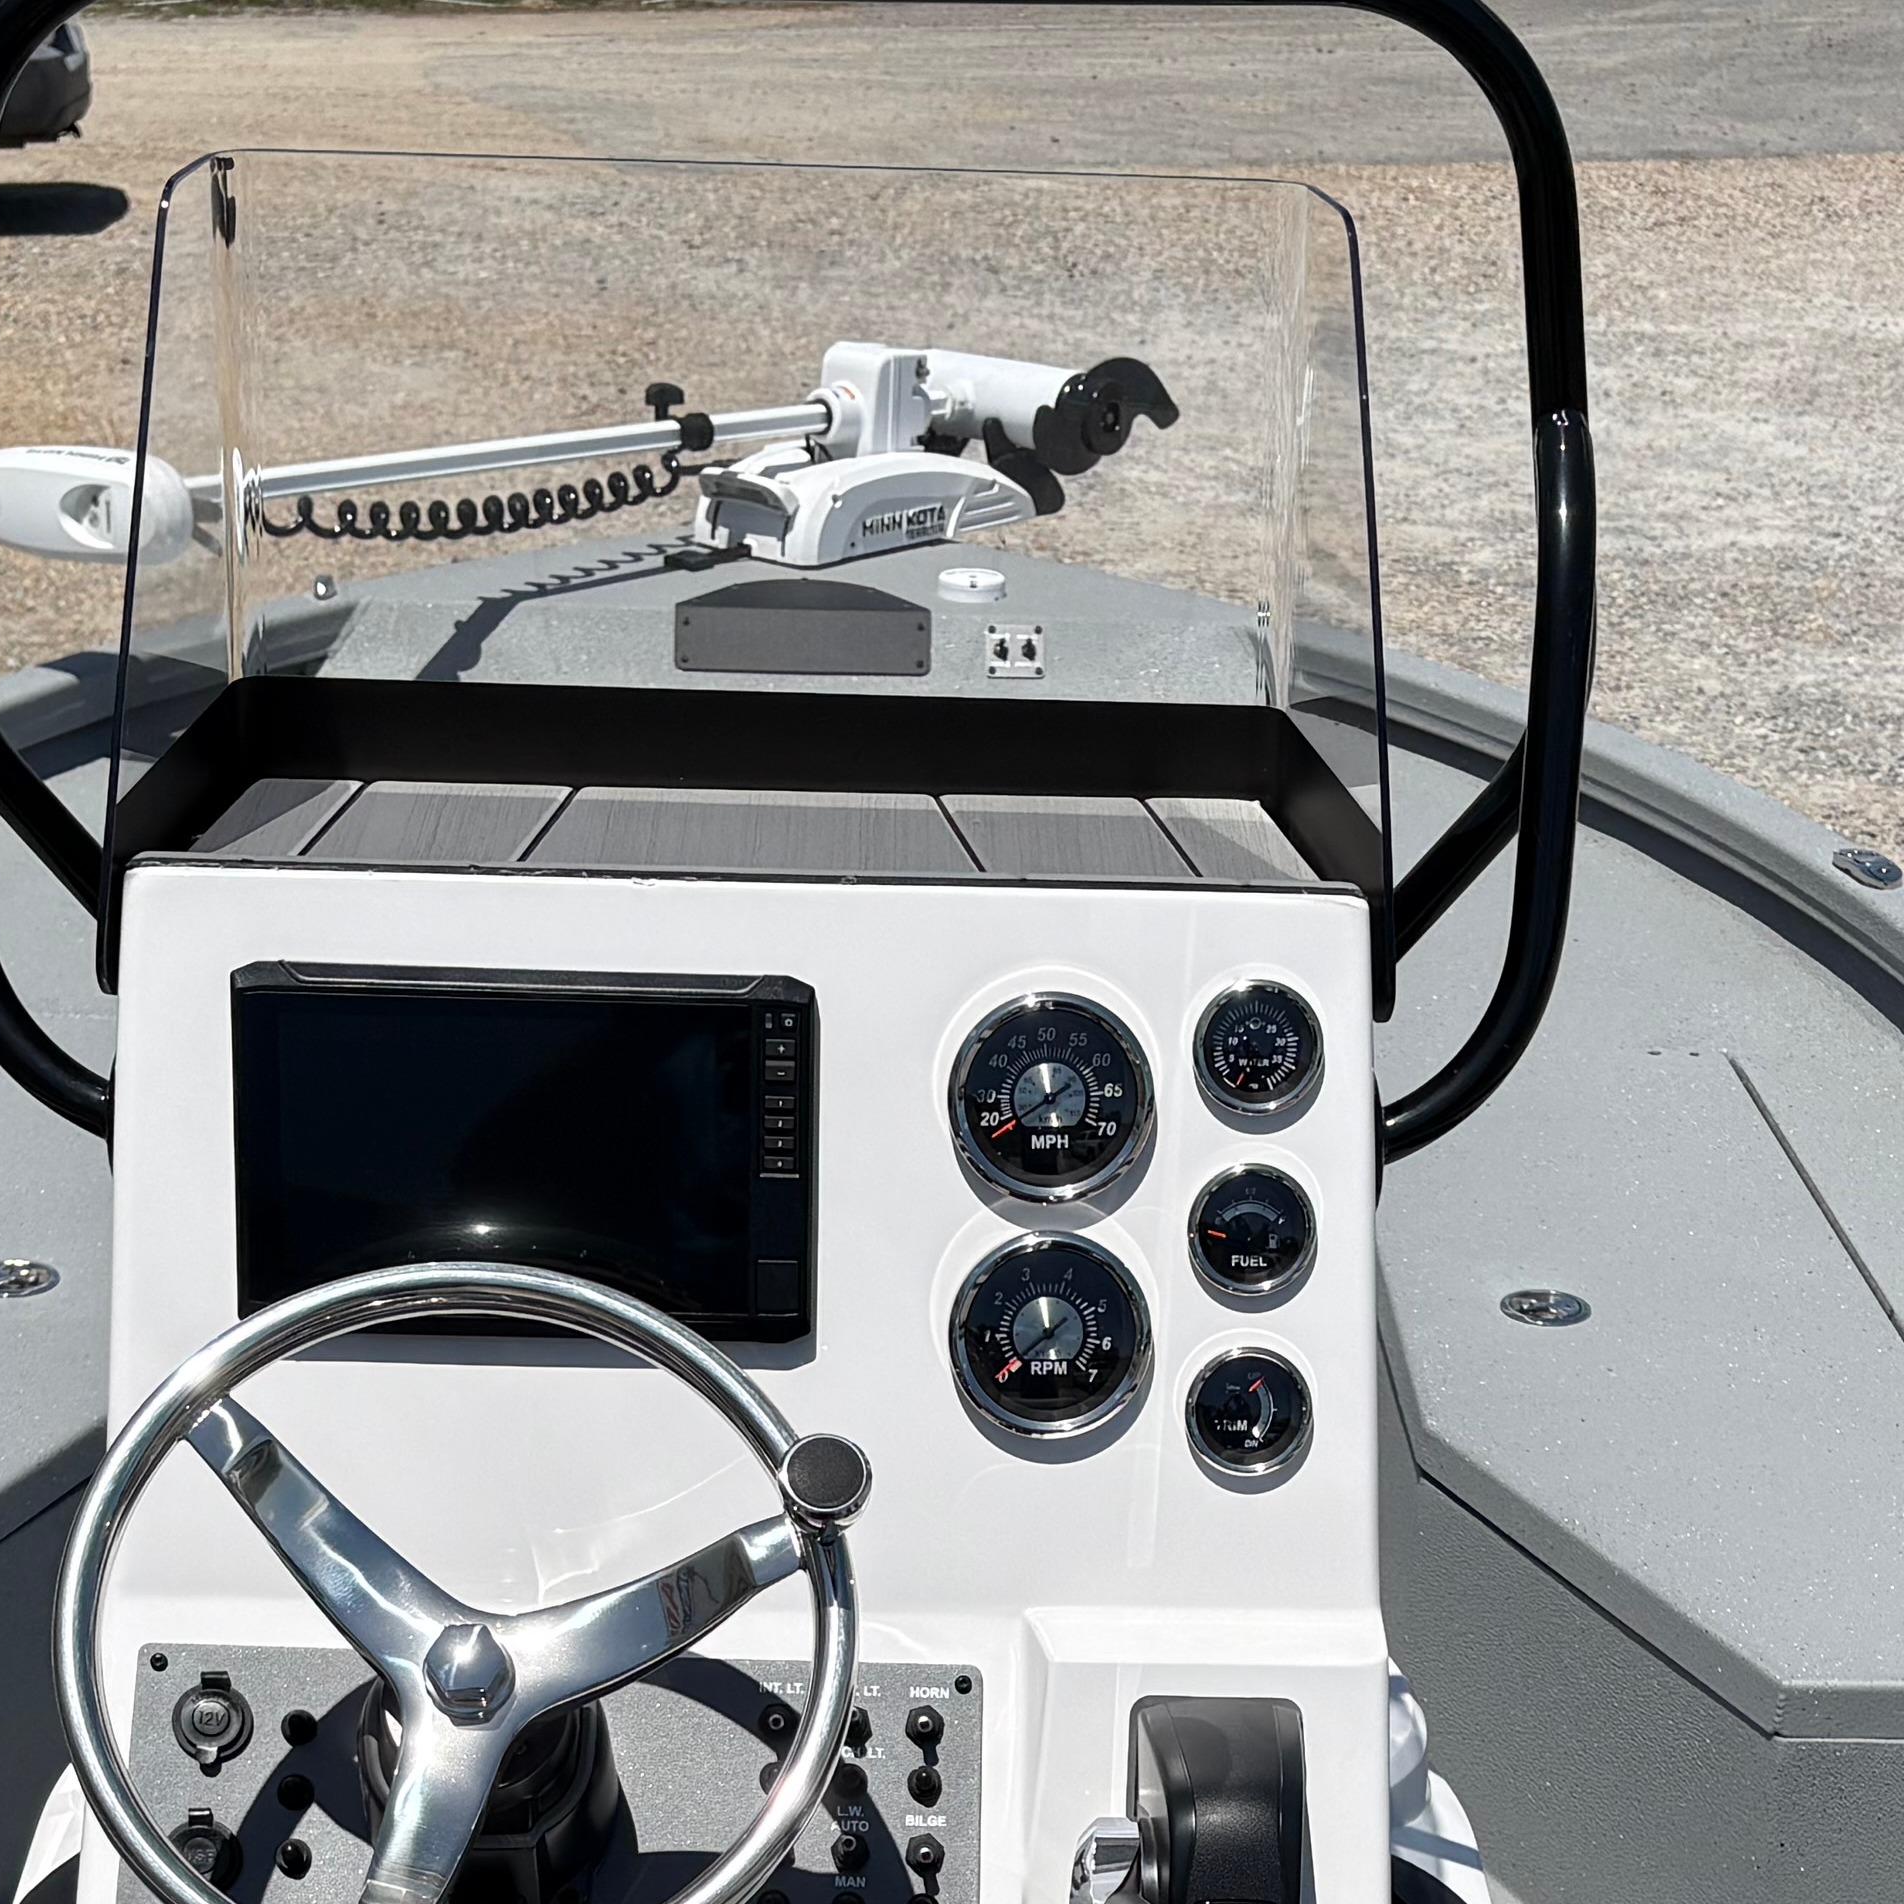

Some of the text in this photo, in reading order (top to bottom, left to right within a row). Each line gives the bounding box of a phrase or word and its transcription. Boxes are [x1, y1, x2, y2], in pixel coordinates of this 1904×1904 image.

[862, 504, 946, 537] MINN KOTA
[1037, 1027, 1056, 1041] 50
[1068, 1033, 1087, 1046] 55
[1008, 1035, 1027, 1049] 45
[988, 1054, 1008, 1068] 40
[1092, 1053, 1110, 1067] 60
[976, 1089, 996, 1103] 30
[1104, 1083, 1123, 1097] 65
[980, 1112, 999, 1126] 20
[1097, 1121, 1116, 1136] 70
[1031, 1134, 1069, 1149] MPH
[1231, 1255, 1268, 1267] FUEL
[1021, 1268, 1031, 1281] 3
[1064, 1268, 1073, 1281] 4
[994, 1292, 1004, 1304] 2
[1097, 1300, 1107, 1313] 5
[984, 1329, 991, 1342] 1
[1101, 1336, 1112, 1350] 6
[1030, 1361, 1067, 1375] RPM
[1088, 1369, 1098, 1382] 7
[759, 1682, 805, 1694] INT. LT.
[863, 1685, 881, 1697] LT.
[909, 1686, 950, 1699] HORN
[199, 1710, 226, 1726] 12V
[868, 1747, 886, 1759] LT.
[837, 1806, 864, 1817] L.W.
[830, 1821, 870, 1832] AUTO
[905, 1815, 947, 1827] BILGE
[835, 1876, 866, 1888] MAN
